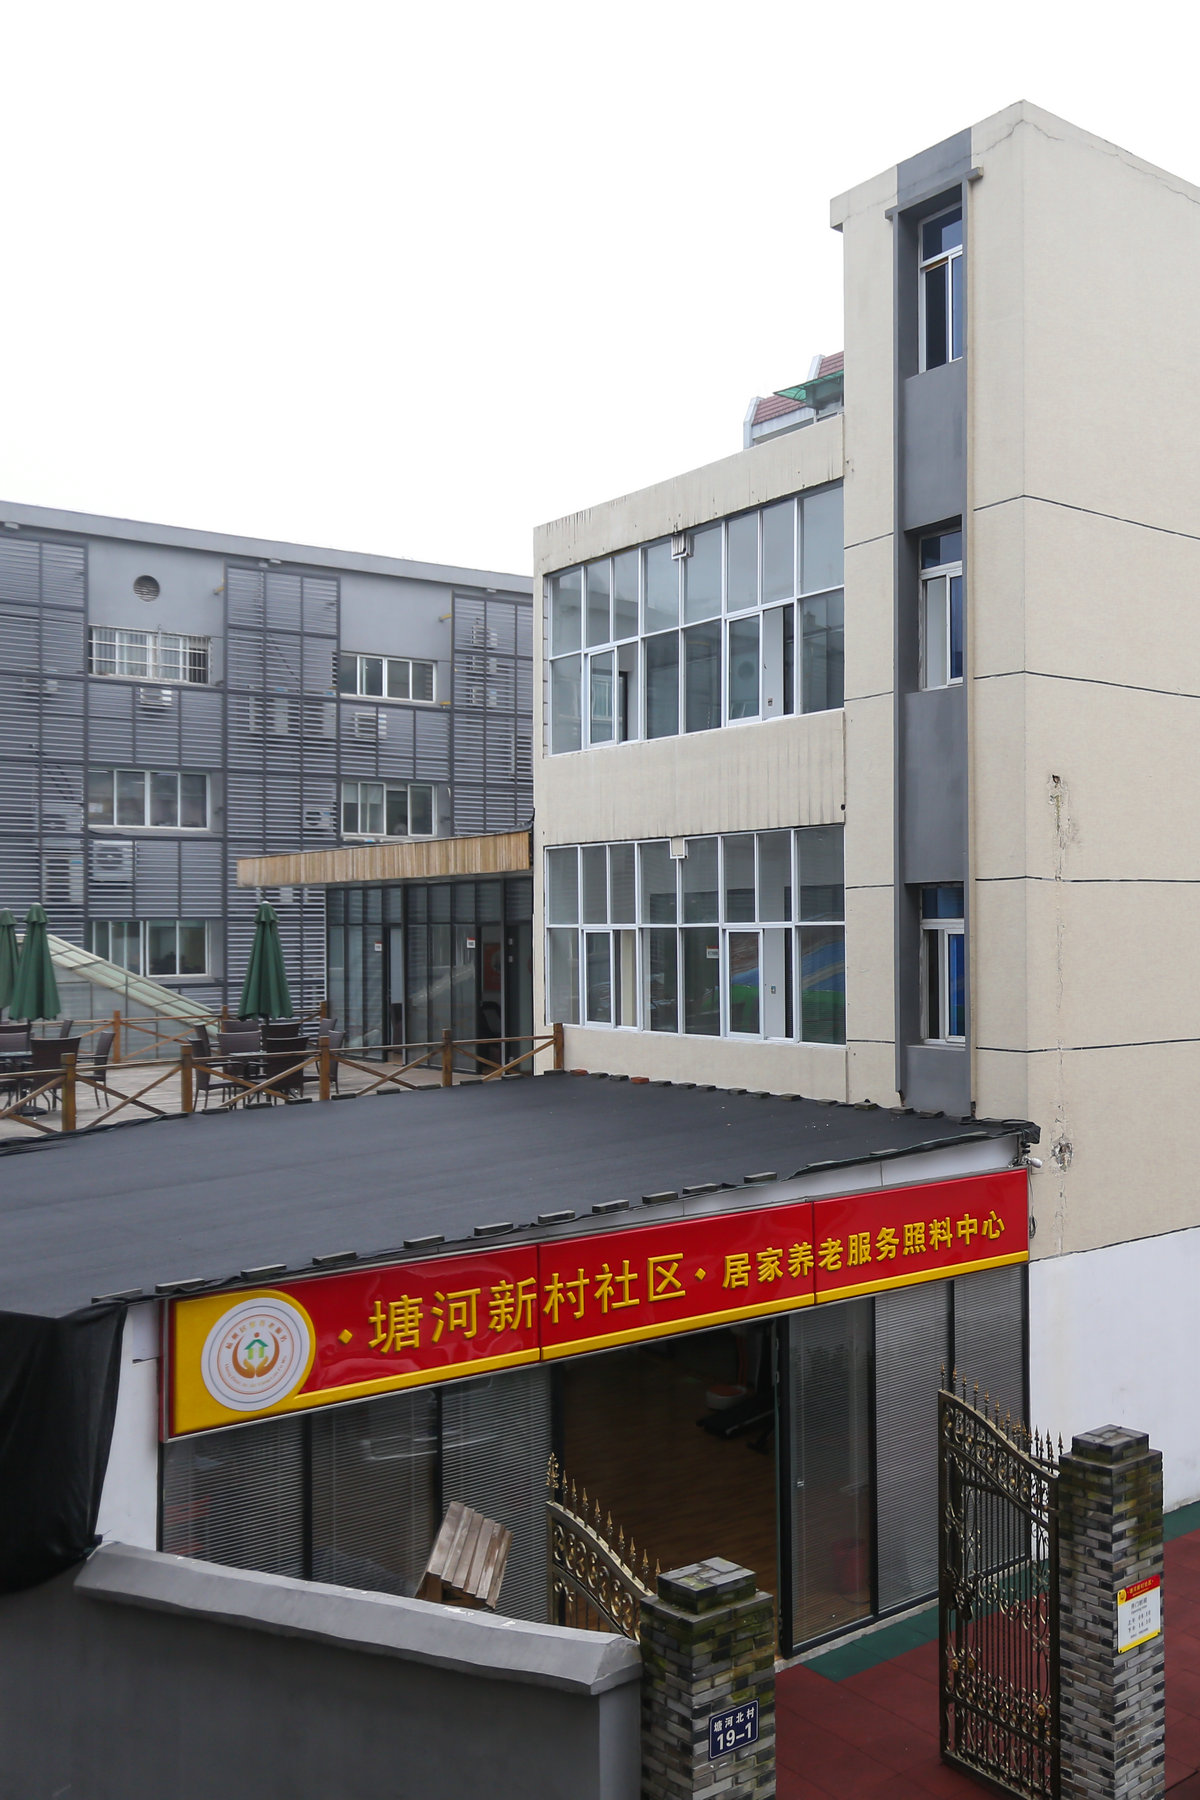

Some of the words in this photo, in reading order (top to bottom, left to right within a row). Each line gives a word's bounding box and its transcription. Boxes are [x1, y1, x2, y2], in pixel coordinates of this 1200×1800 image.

[713, 1707, 755, 1732] 塘河北村
[716, 1722, 752, 1750] 19-1
